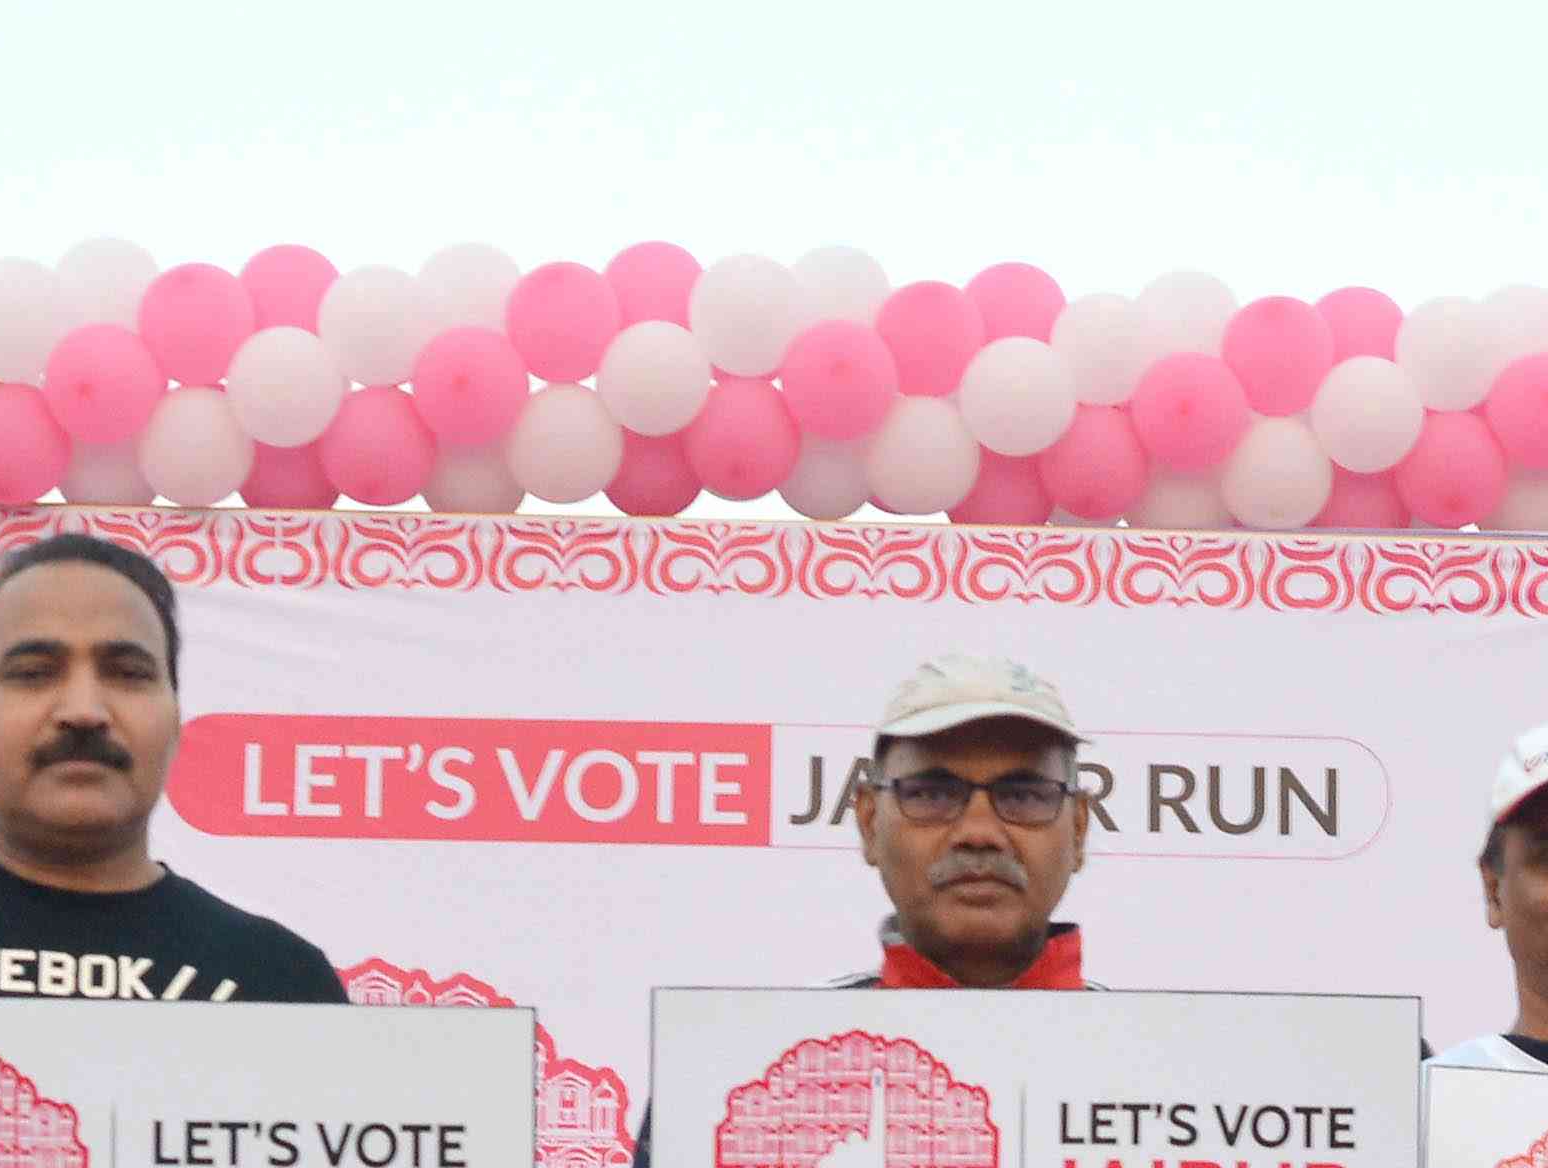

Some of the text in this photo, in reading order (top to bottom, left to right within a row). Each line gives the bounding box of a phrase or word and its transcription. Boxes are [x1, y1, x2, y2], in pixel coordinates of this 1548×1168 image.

[243, 743, 475, 820] LET'S
[495, 748, 749, 827] VOTE
[1148, 764, 1337, 836] RUN
[154, 1121, 467, 1168] LET'S VOTE
[1060, 1102, 1355, 1149] LET'S VOTE
